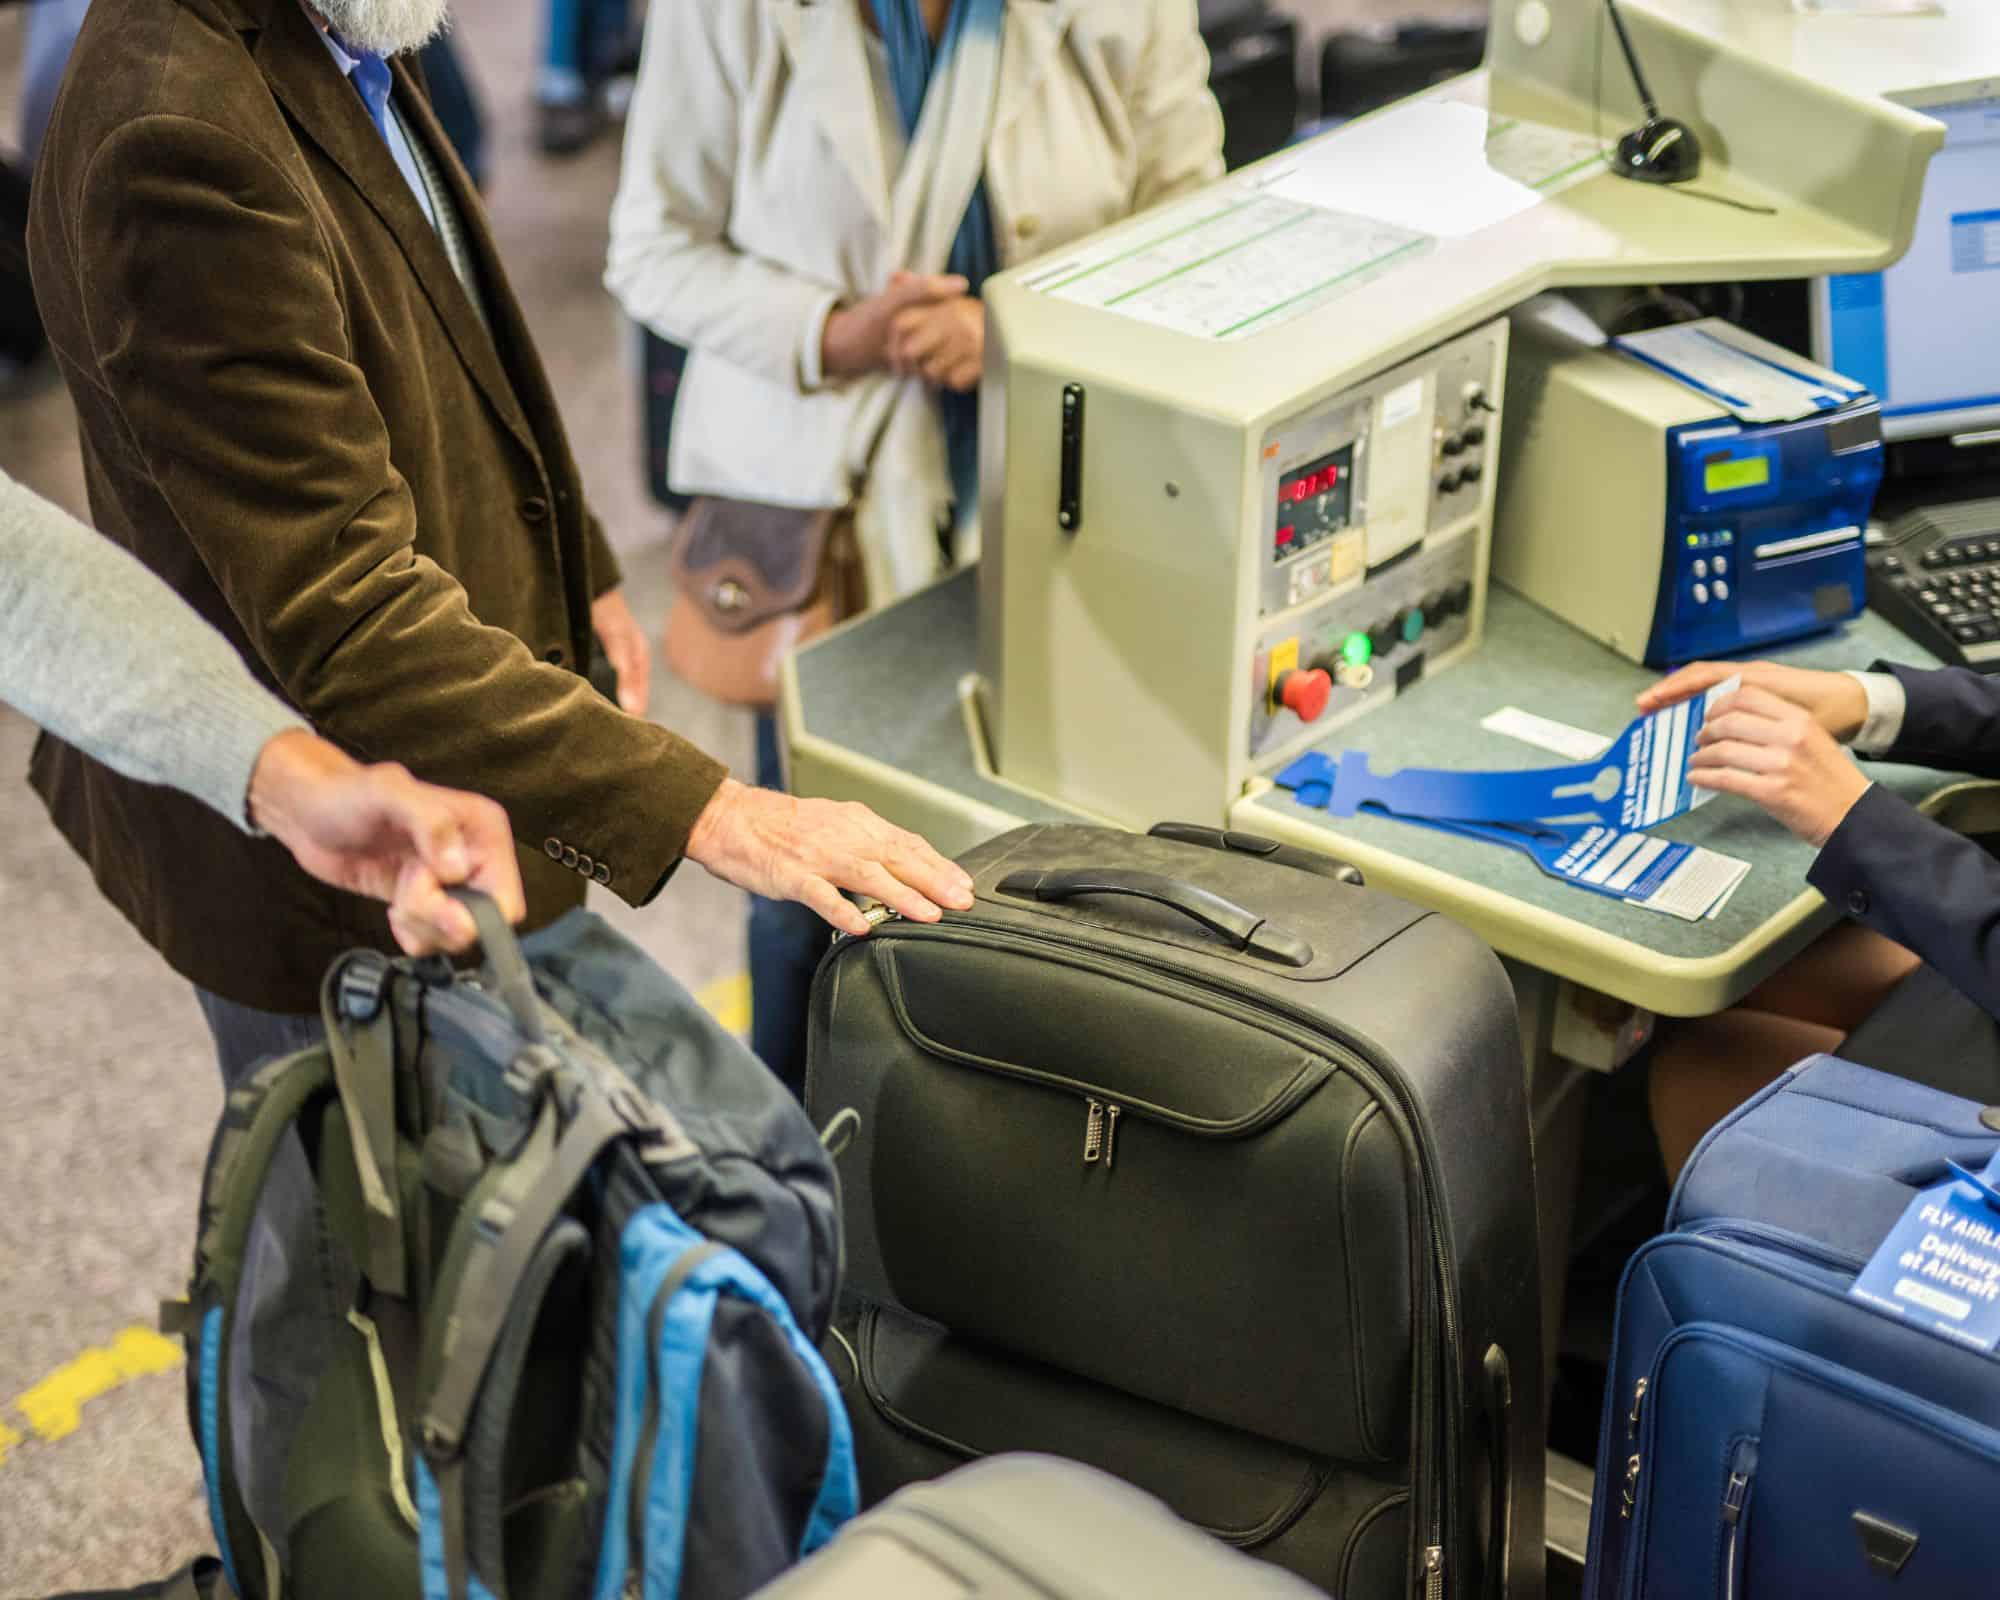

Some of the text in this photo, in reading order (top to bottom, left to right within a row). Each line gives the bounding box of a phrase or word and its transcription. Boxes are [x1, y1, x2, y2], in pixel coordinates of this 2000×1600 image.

[1919, 1205, 1955, 1228] FLY
[1899, 1251, 1999, 1299] at Aircraft
[1920, 1233, 2000, 1280] Delivery
